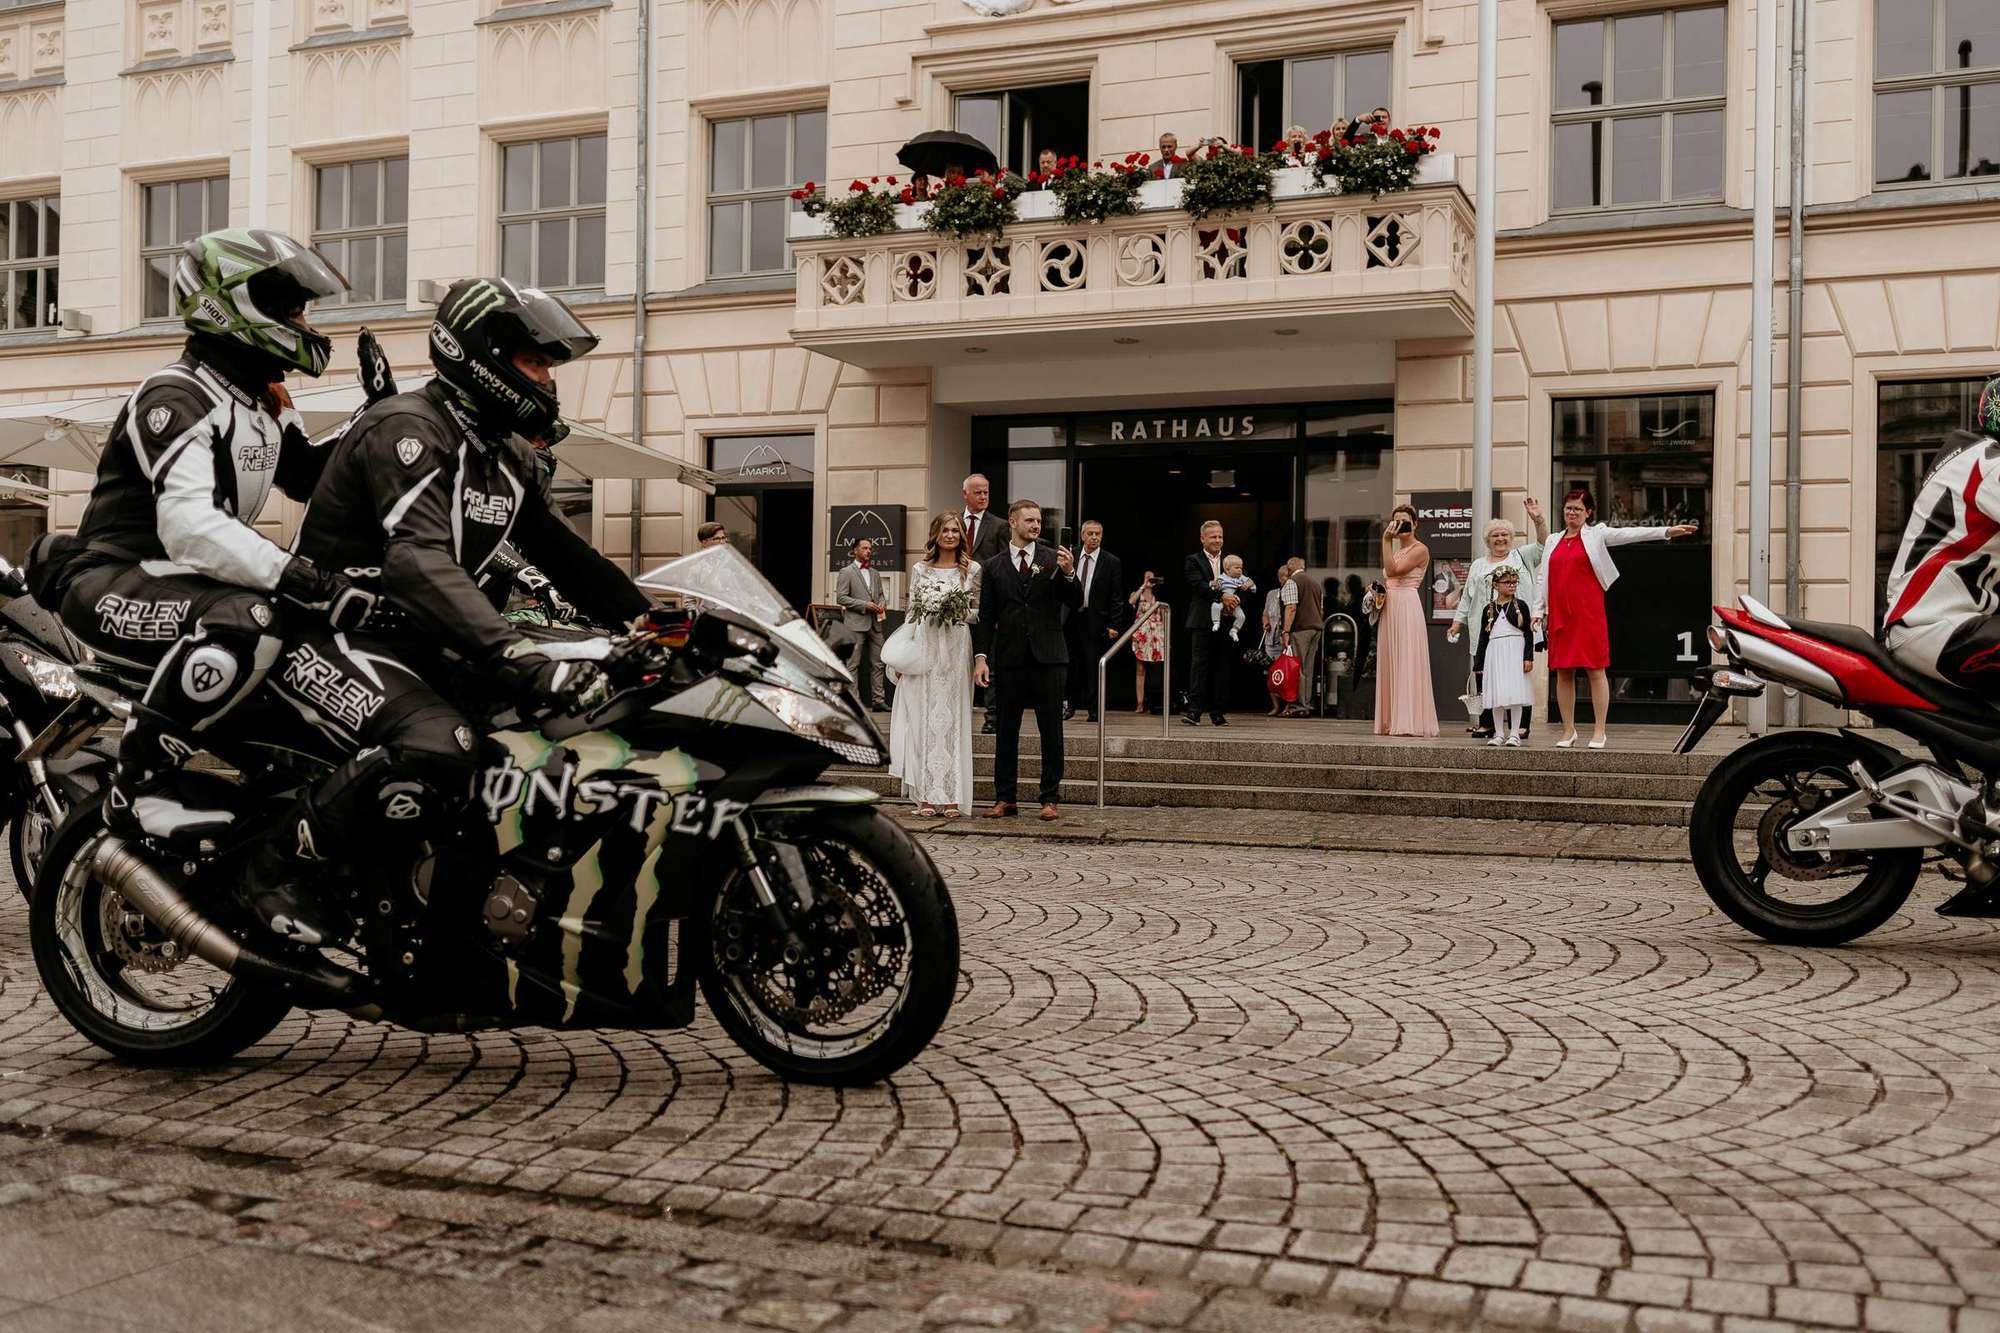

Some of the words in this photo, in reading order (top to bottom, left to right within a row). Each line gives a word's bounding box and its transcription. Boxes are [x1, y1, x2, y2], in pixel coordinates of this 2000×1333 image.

[1111, 416, 1254, 440] RATHAUS
[745, 467, 782, 476] MARKT
[463, 487, 513, 511] ARLEN
[464, 503, 508, 526] NESS
[1418, 508, 1472, 519] KRES
[1438, 521, 1471, 530] MODE
[843, 537, 888, 547] MKT
[95, 594, 191, 621] ARLEN
[100, 612, 179, 640] NESS
[1676, 631, 1698, 661] 1
[286, 643, 385, 717] ARLEN
[283, 661, 364, 731] NESS
